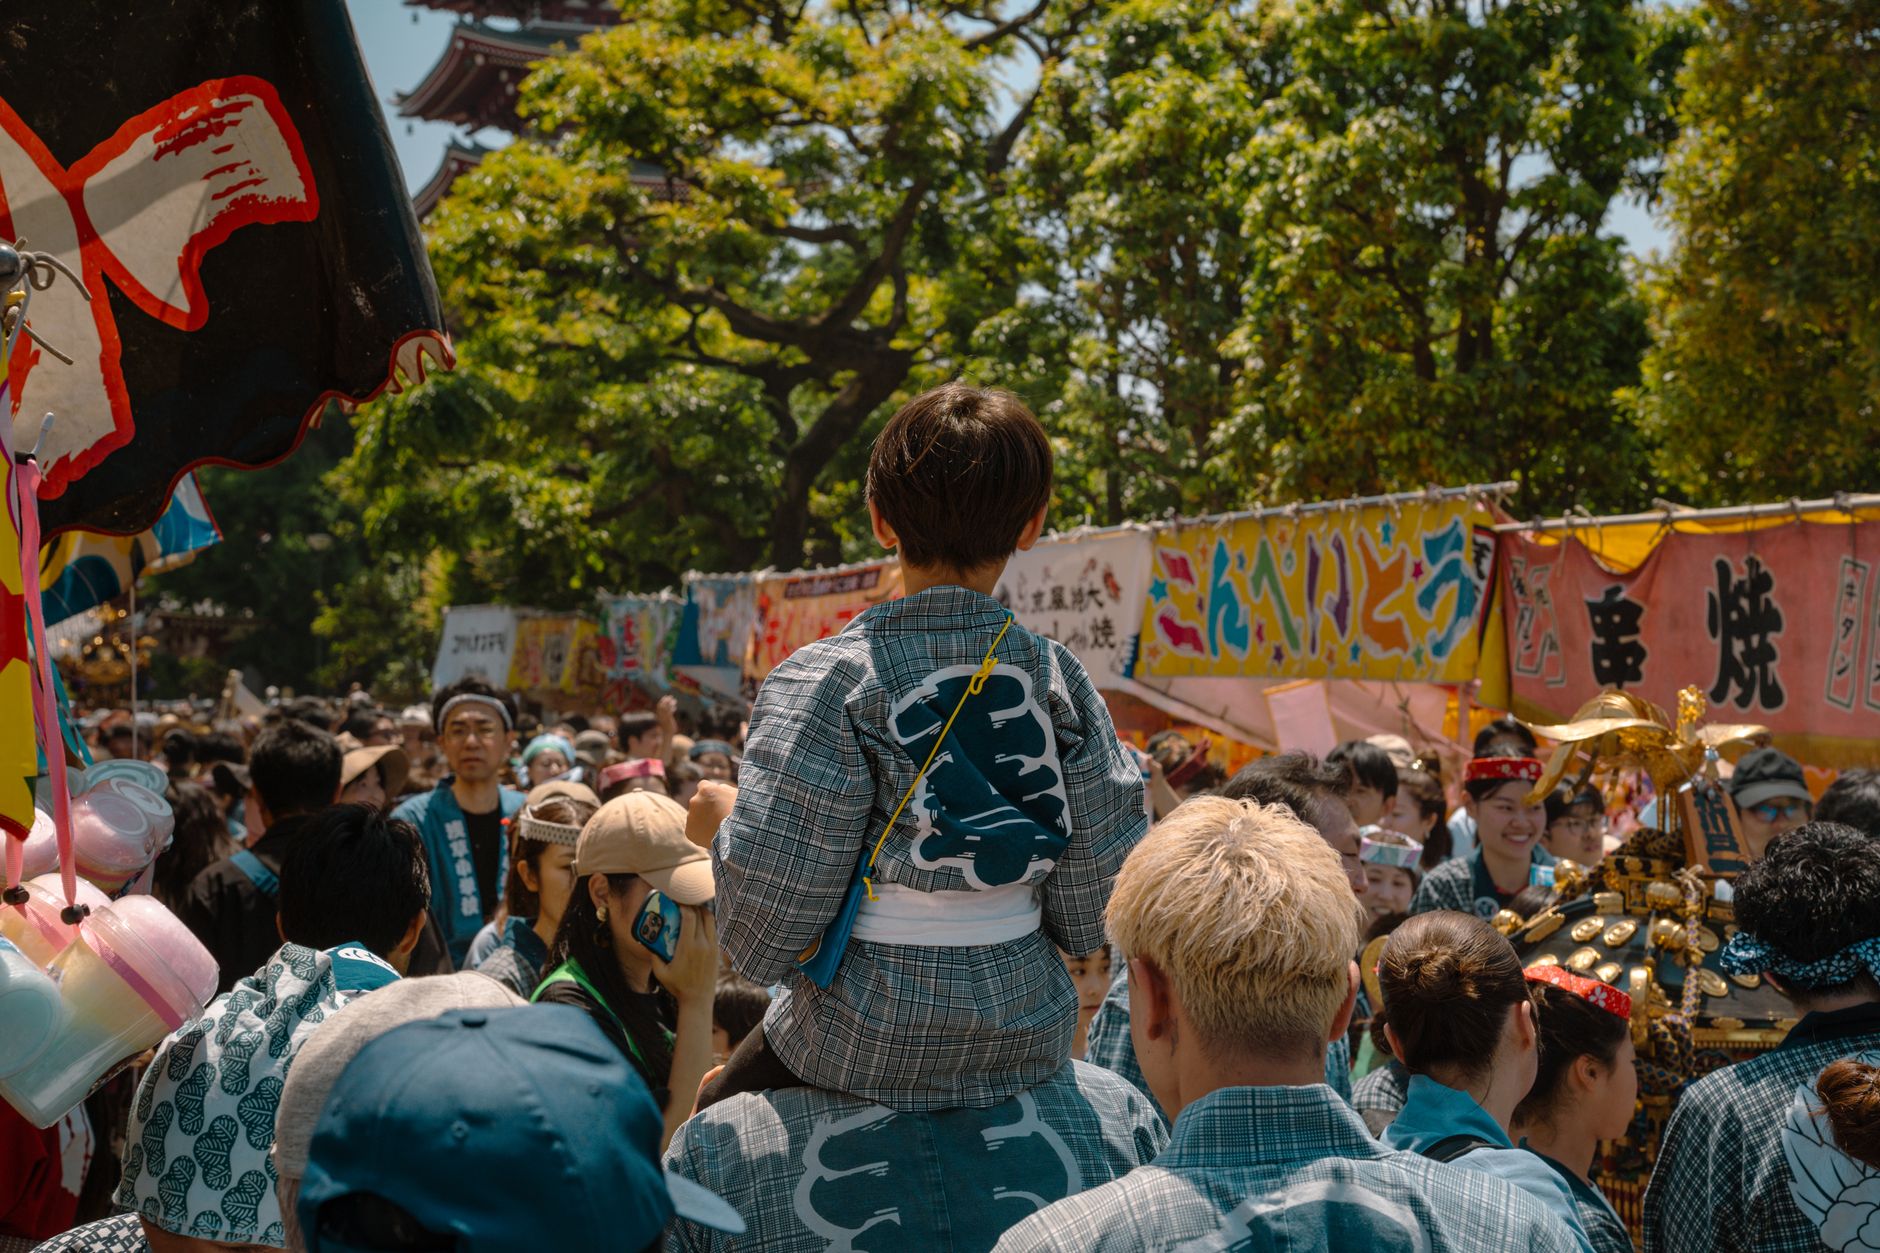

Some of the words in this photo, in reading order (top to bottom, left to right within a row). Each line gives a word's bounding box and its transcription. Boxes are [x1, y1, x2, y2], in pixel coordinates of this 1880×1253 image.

[1157, 516, 1481, 662] こんぺいとう
